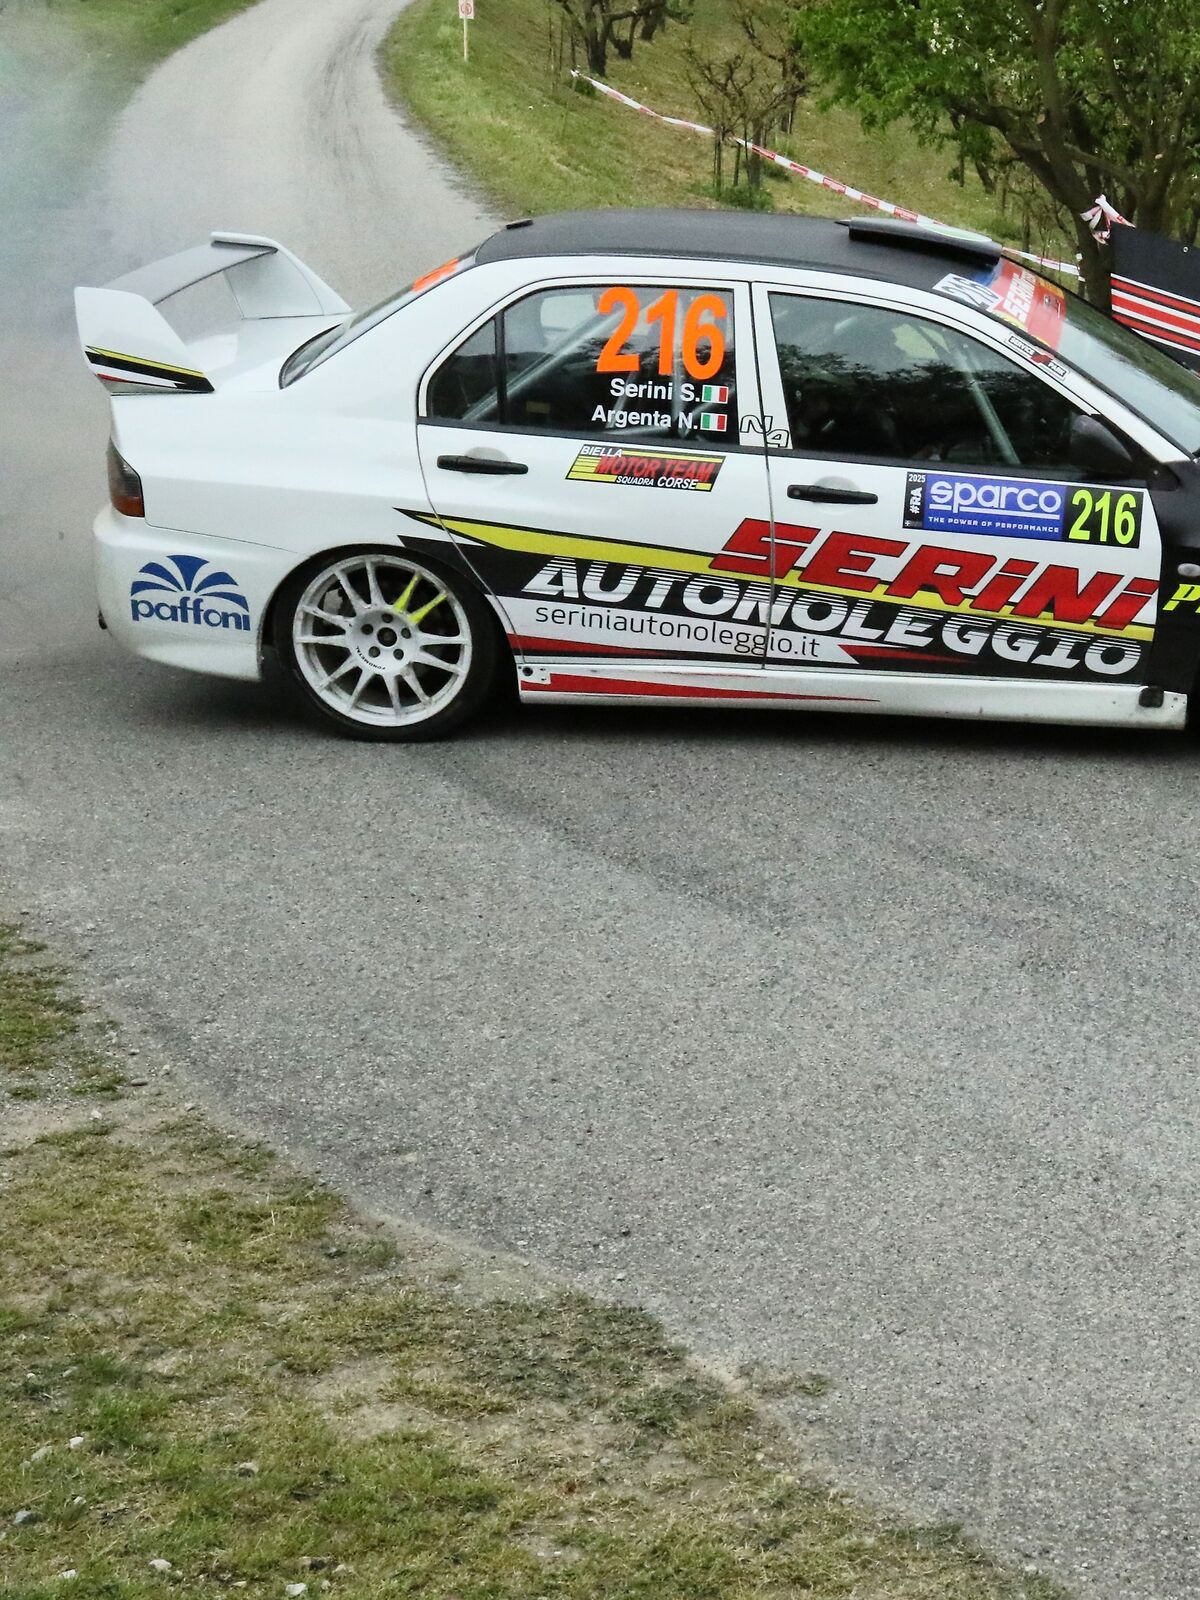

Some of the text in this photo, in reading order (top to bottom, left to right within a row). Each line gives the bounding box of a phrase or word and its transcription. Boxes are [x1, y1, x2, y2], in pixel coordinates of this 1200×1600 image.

[596, 287, 727, 380] 216
[610, 378, 701, 403] Serini S.
[591, 405, 699, 430] Argenta N.
[580, 446, 623, 458] BIELLA
[594, 457, 716, 482] MOTOR TEAM
[616, 475, 699, 490] SQUADRA CORSE
[908, 473, 926, 483] 2025
[910, 487, 922, 514] #RA
[930, 480, 1061, 514] sparco
[948, 518, 978, 526] POWER
[995, 522, 1060, 533] PERFORMANCE
[1068, 489, 1137, 545] 216
[130, 596, 251, 631] paffoni
[521, 556, 1142, 675] AUTONOLEGGIO
[535, 606, 820, 658] seriniautonoleggio.it
